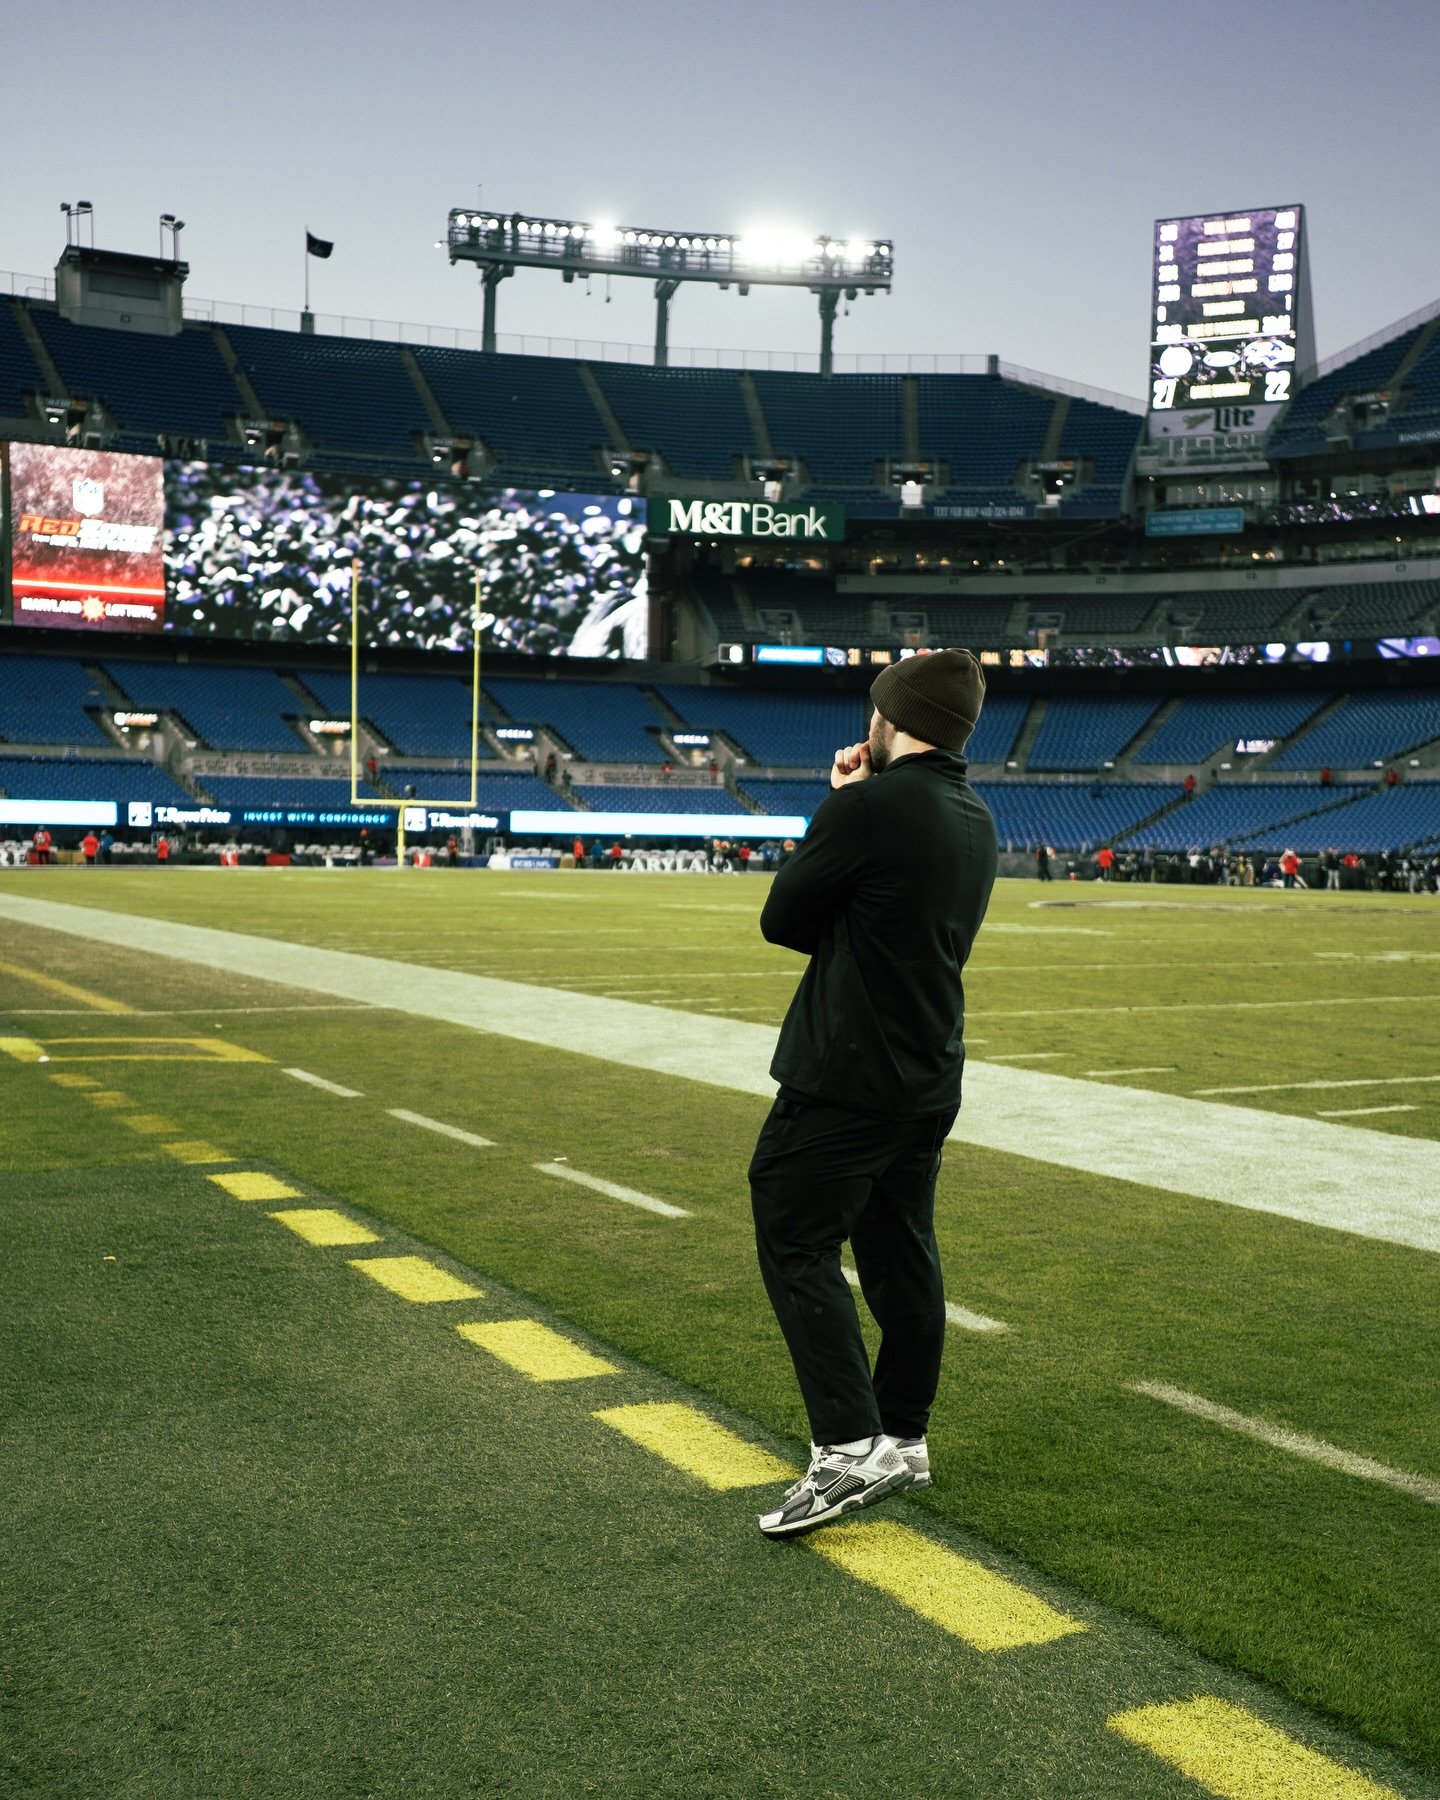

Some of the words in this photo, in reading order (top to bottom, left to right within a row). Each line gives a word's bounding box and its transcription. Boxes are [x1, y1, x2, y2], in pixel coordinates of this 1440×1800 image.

[1213, 407, 1255, 433] Lite
[668, 499, 750, 535] M&T
[751, 503, 828, 538] Bank
